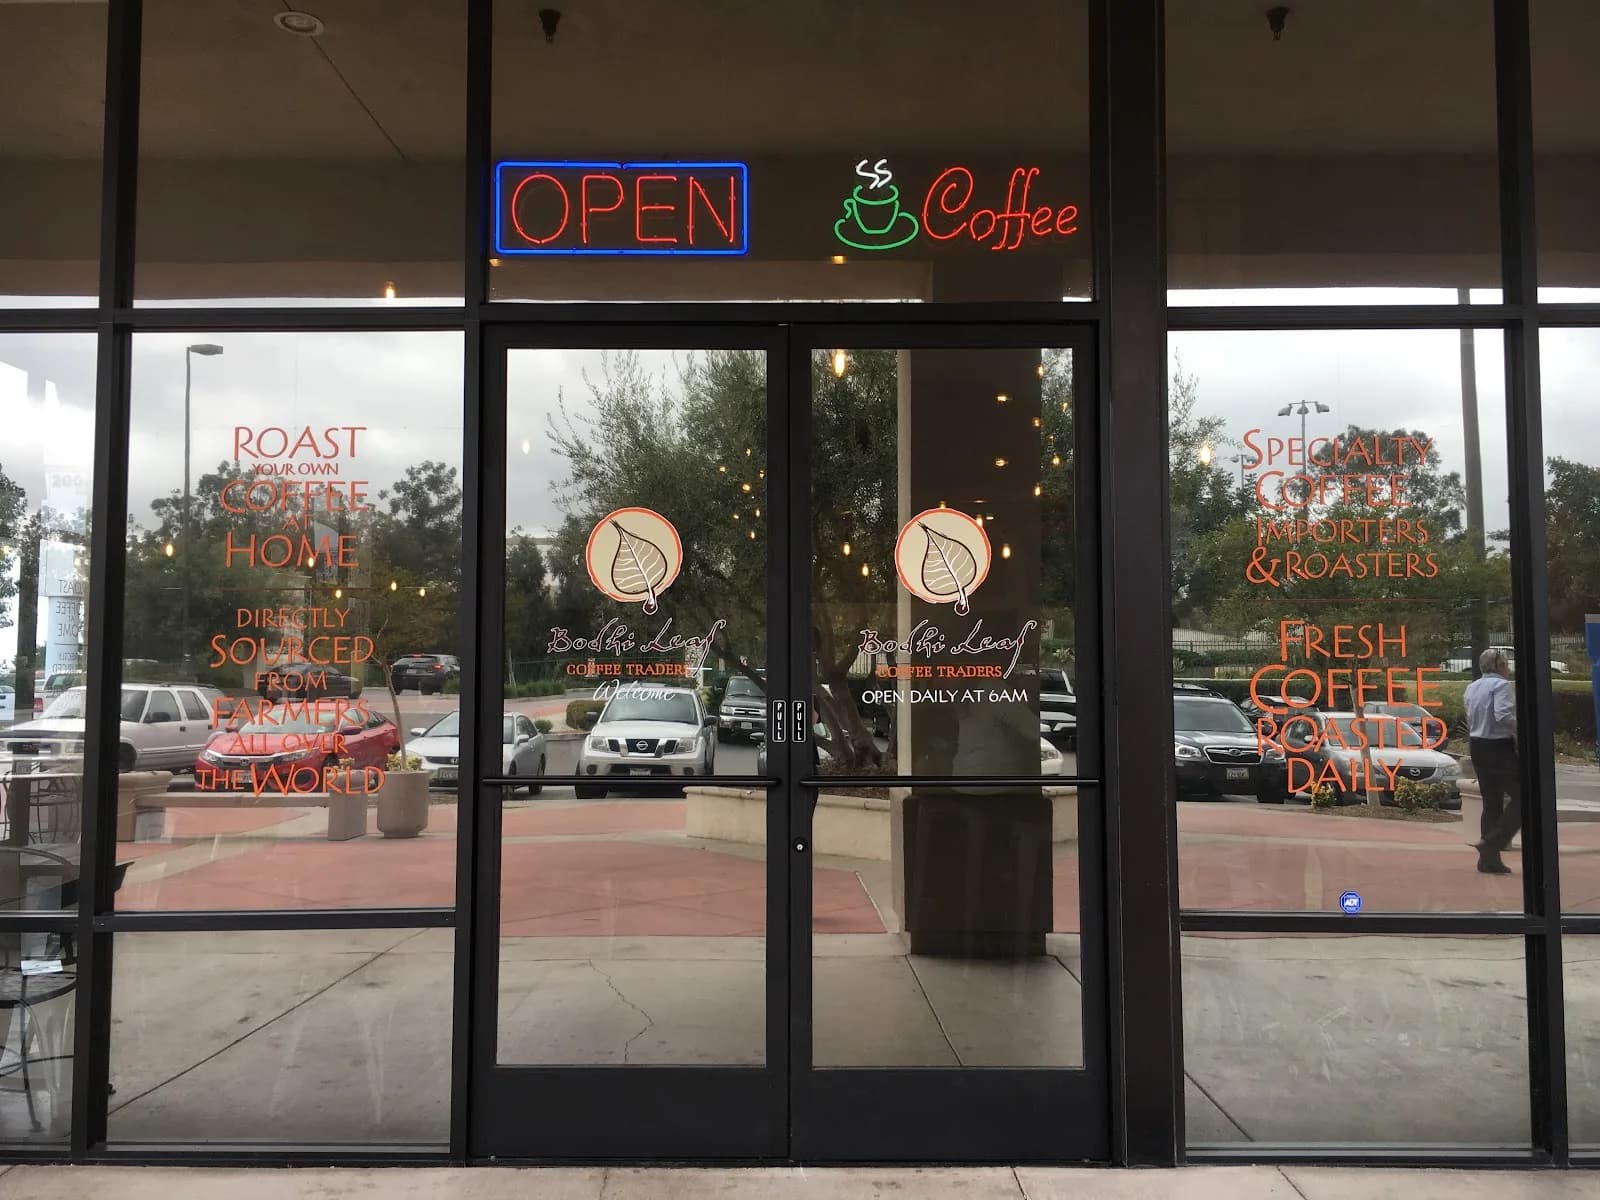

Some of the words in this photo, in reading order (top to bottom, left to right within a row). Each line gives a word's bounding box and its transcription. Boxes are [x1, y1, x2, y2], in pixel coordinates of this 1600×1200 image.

[511, 173, 736, 244] OPEN
[922, 167, 1078, 250] Coffee
[234, 426, 367, 460] ROAST
[1242, 429, 1433, 470] SPECIALTY
[252, 463, 296, 475] YOUR
[298, 463, 339, 475] OWN
[220, 480, 369, 513] COFFEE
[1255, 470, 1413, 511] COFFEE
[281, 514, 314, 530] AT
[1256, 517, 1430, 546] IMPORTERS
[225, 530, 359, 568] HOME
[236, 607, 350, 628] DIRECTLY
[210, 634, 375, 668] SOURCED
[547, 617, 635, 656] Bodhi
[640, 617, 727, 677] Leaf
[858, 618, 946, 658] Bodhi
[950, 618, 1038, 679] Leaf
[1280, 620, 1407, 662] FRESH
[254, 671, 327, 691] FROM
[566, 663, 622, 676] COFFEE
[625, 663, 690, 676] TRADERS
[875, 665, 933, 678] COFFEE
[937, 665, 1003, 678] TRADERS
[593, 679, 676, 701] Welcome
[862, 690, 904, 704] OPEN
[911, 690, 959, 704] DAILY
[961, 690, 985, 704] AT
[988, 690, 1029, 704] 6AM
[1249, 664, 1443, 715] COFFEE
[212, 696, 371, 729] FARMERS
[228, 733, 272, 753] ALL
[282, 733, 349, 753] OVER
[1256, 715, 1449, 756] ROASTED
[196, 768, 246, 790] THE
[250, 763, 386, 797] WORLD
[1286, 757, 1404, 793] DAILY
